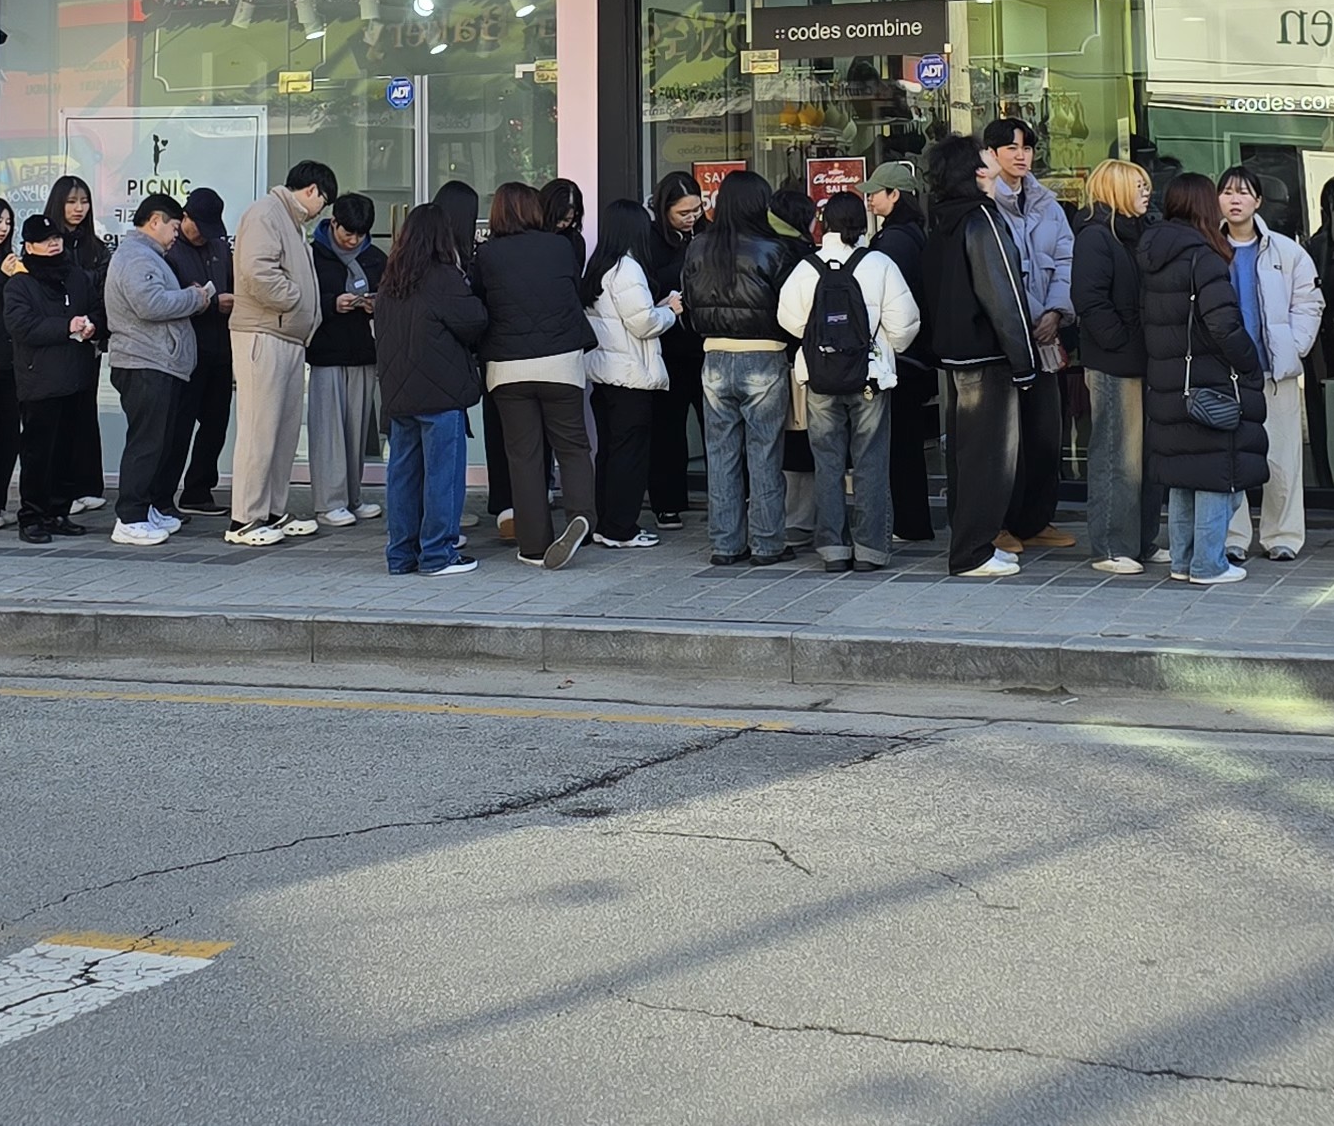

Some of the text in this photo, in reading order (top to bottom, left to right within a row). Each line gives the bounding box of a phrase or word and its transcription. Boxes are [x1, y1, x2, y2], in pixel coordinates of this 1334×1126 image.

[846, 18, 923, 38] combine
[921, 63, 944, 78] ADT
[391, 85, 411, 99] ADT
[127, 178, 192, 196] PICNIC
